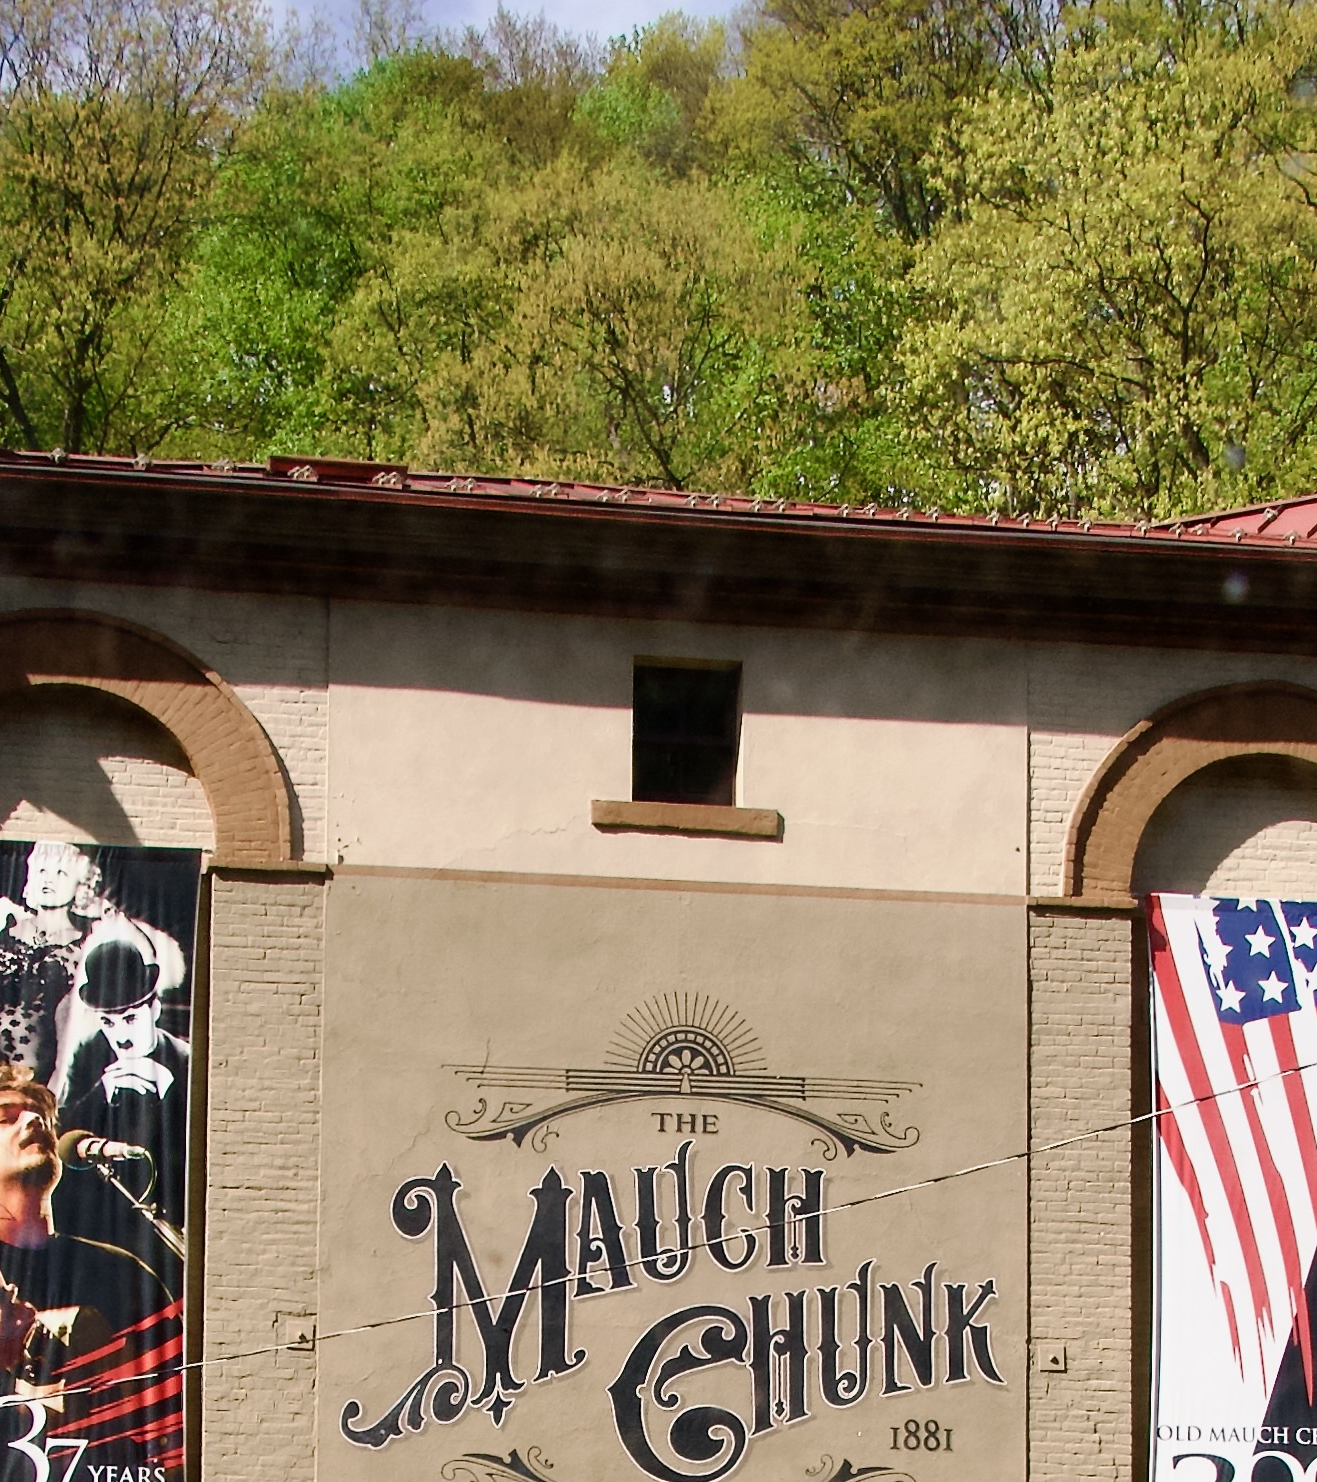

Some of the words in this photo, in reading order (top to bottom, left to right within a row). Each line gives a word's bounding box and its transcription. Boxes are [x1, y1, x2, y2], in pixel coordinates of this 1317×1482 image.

[651, 1111, 720, 1135] THE
[340, 1140, 829, 1450] MAUCH
[889, 1420, 955, 1453] 1881
[1157, 1424, 1202, 1442] OLD
[1209, 1425, 1289, 1446] MAUCH
